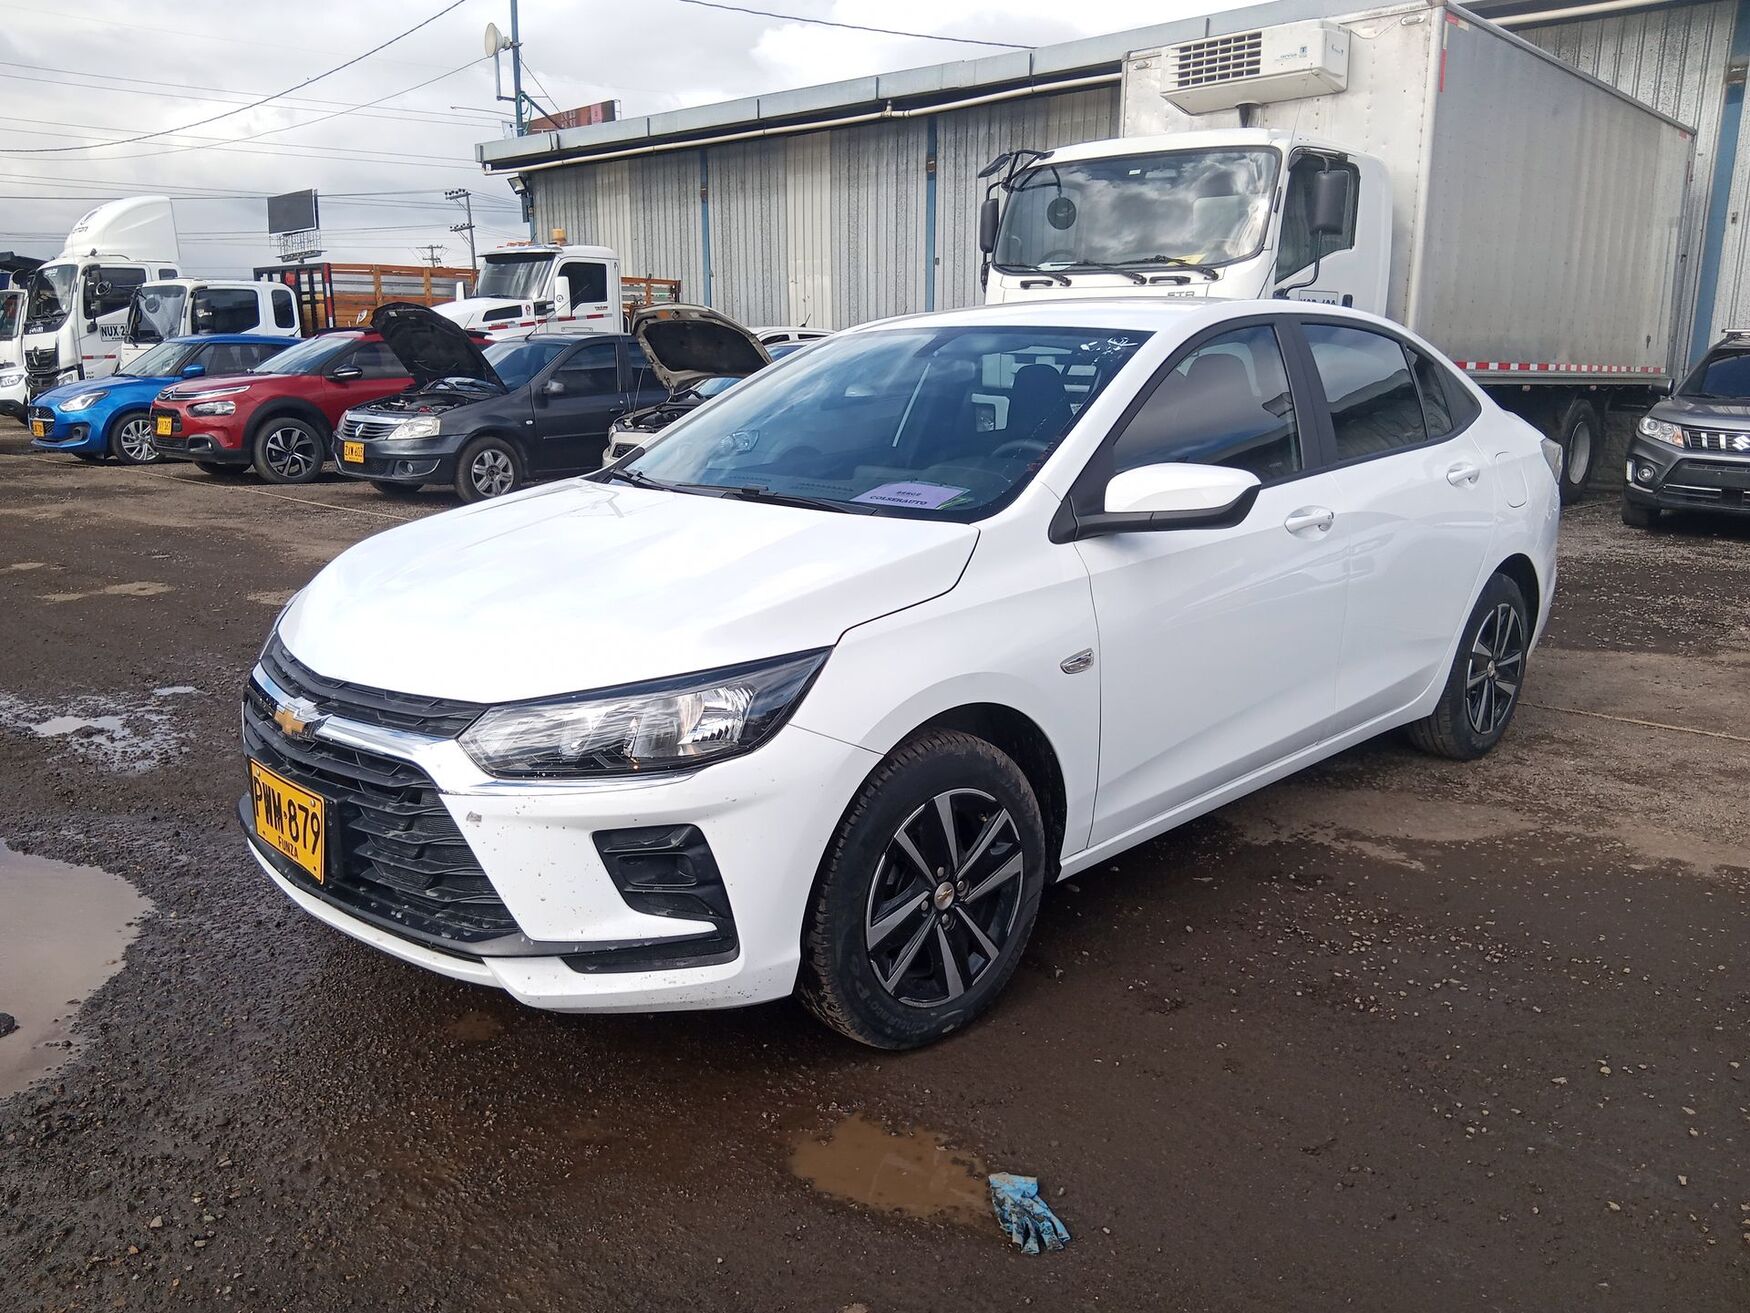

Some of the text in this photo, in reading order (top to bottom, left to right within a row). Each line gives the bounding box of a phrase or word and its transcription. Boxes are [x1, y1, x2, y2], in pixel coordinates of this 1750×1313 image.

[101, 325, 119, 337] NUX
[870, 495, 928, 505] COLSERAUTO
[278, 836, 299, 860] FUNZA
